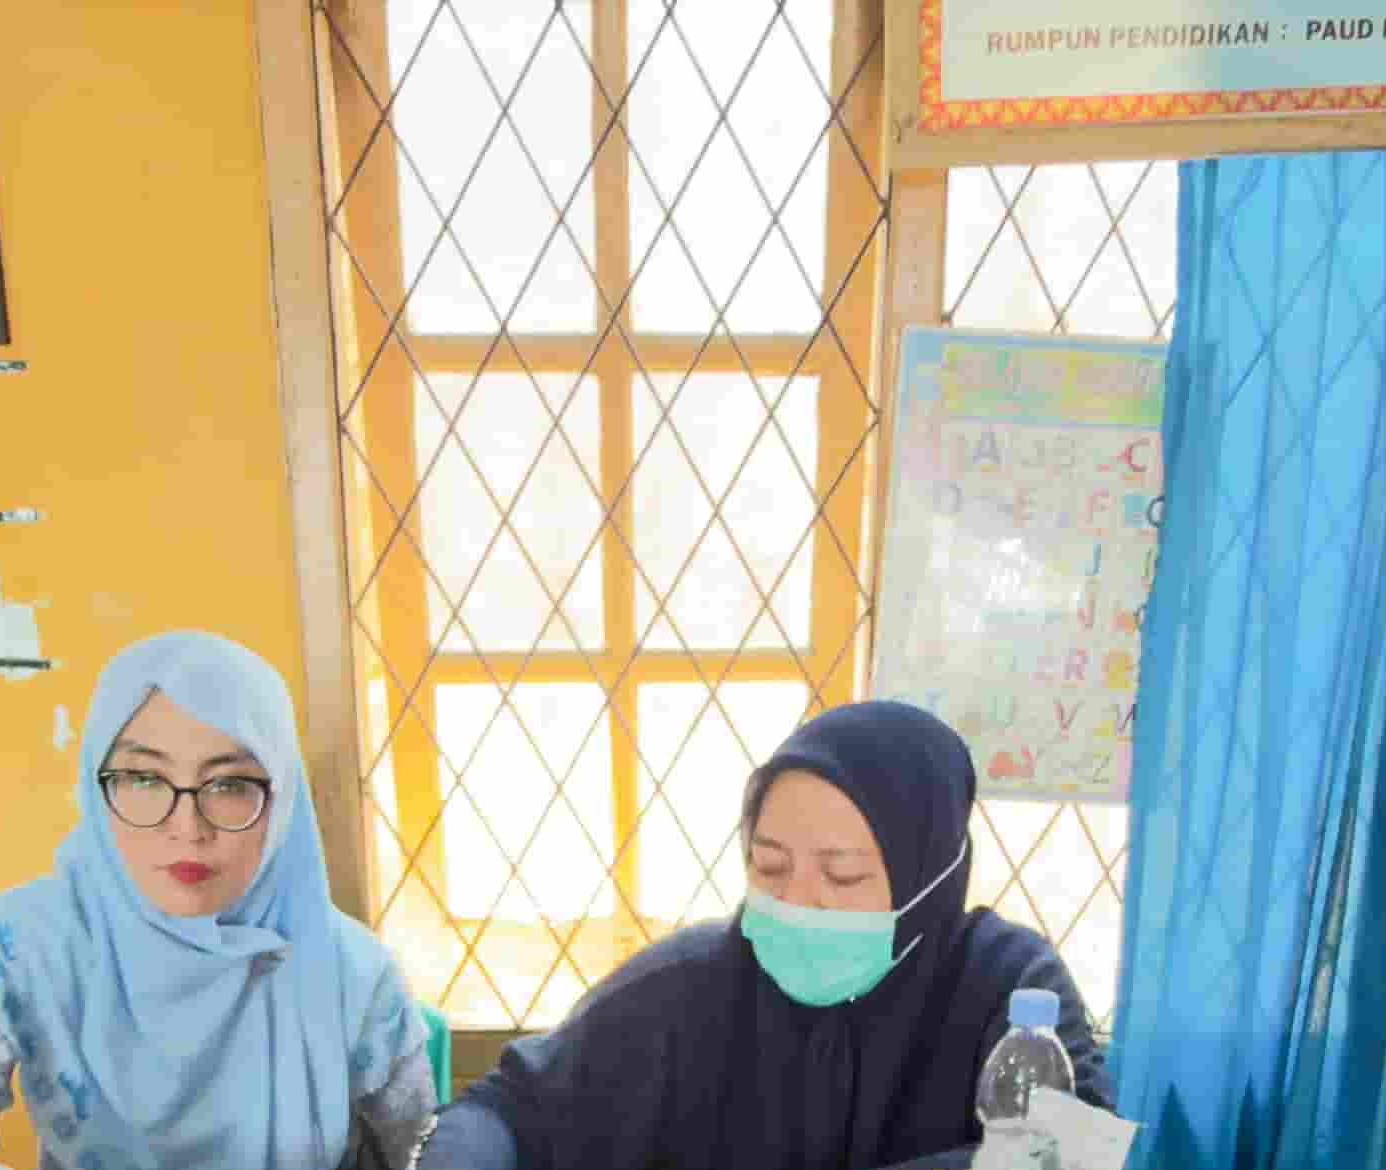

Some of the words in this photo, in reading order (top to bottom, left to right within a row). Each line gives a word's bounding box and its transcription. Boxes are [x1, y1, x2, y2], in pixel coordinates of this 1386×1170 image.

[986, 24, 1102, 56] RUMPUN
[1109, 21, 1270, 50] PENDIDIKAN
[1305, 17, 1374, 41] PAUD
